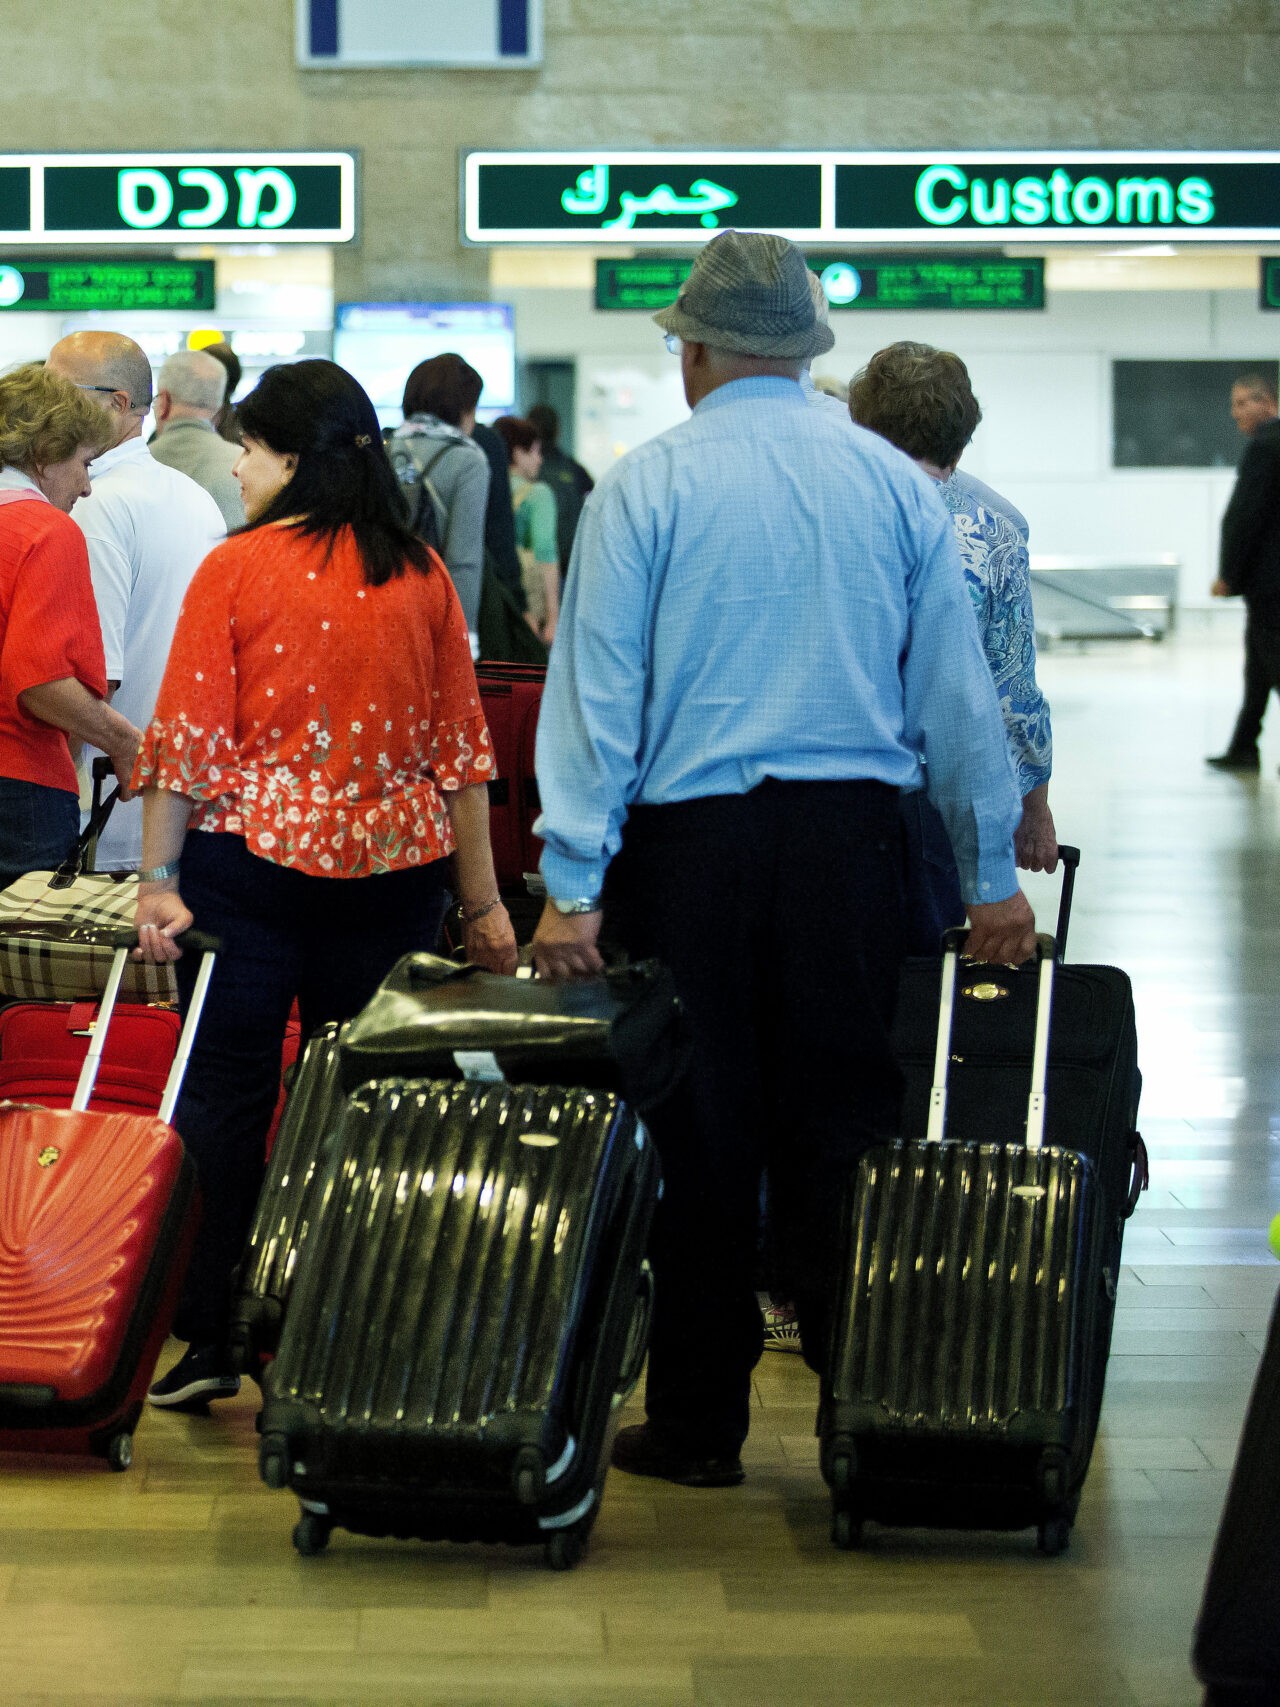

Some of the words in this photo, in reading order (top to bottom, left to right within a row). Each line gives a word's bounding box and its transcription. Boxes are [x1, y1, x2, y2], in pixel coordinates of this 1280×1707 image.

[117, 166, 297, 230] מכס
[561, 164, 739, 229] جمرك
[914, 163, 1215, 226] Customs
